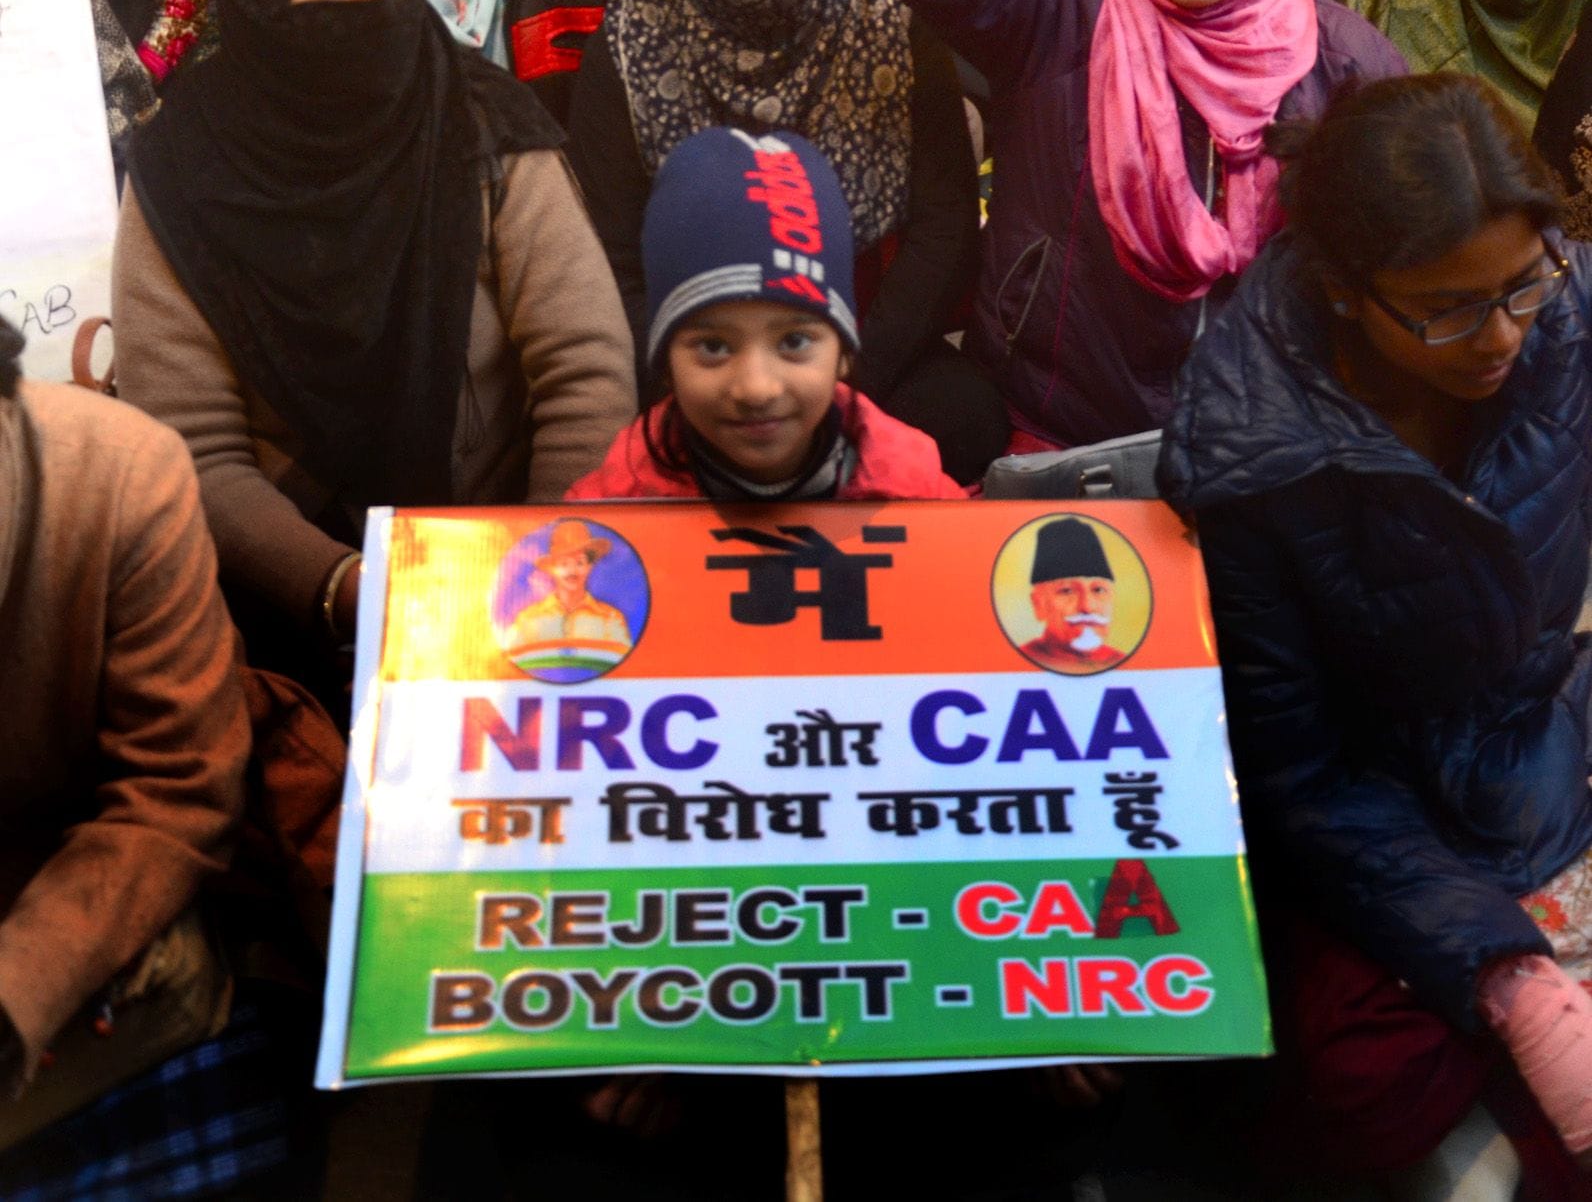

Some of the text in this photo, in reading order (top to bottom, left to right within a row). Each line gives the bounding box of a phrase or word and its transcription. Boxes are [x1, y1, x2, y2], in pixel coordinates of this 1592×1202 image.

[706, 525, 907, 641] मैं
[459, 687, 1171, 773] NRC और CAA
[451, 797, 573, 846] का
[598, 781, 831, 844] विरोध
[857, 787, 1076, 838] करता
[475, 885, 867, 951] REJECT
[955, 858, 1181, 940] CAA
[427, 960, 909, 1034] BOYCOTT
[998, 954, 1215, 1020] NRC
